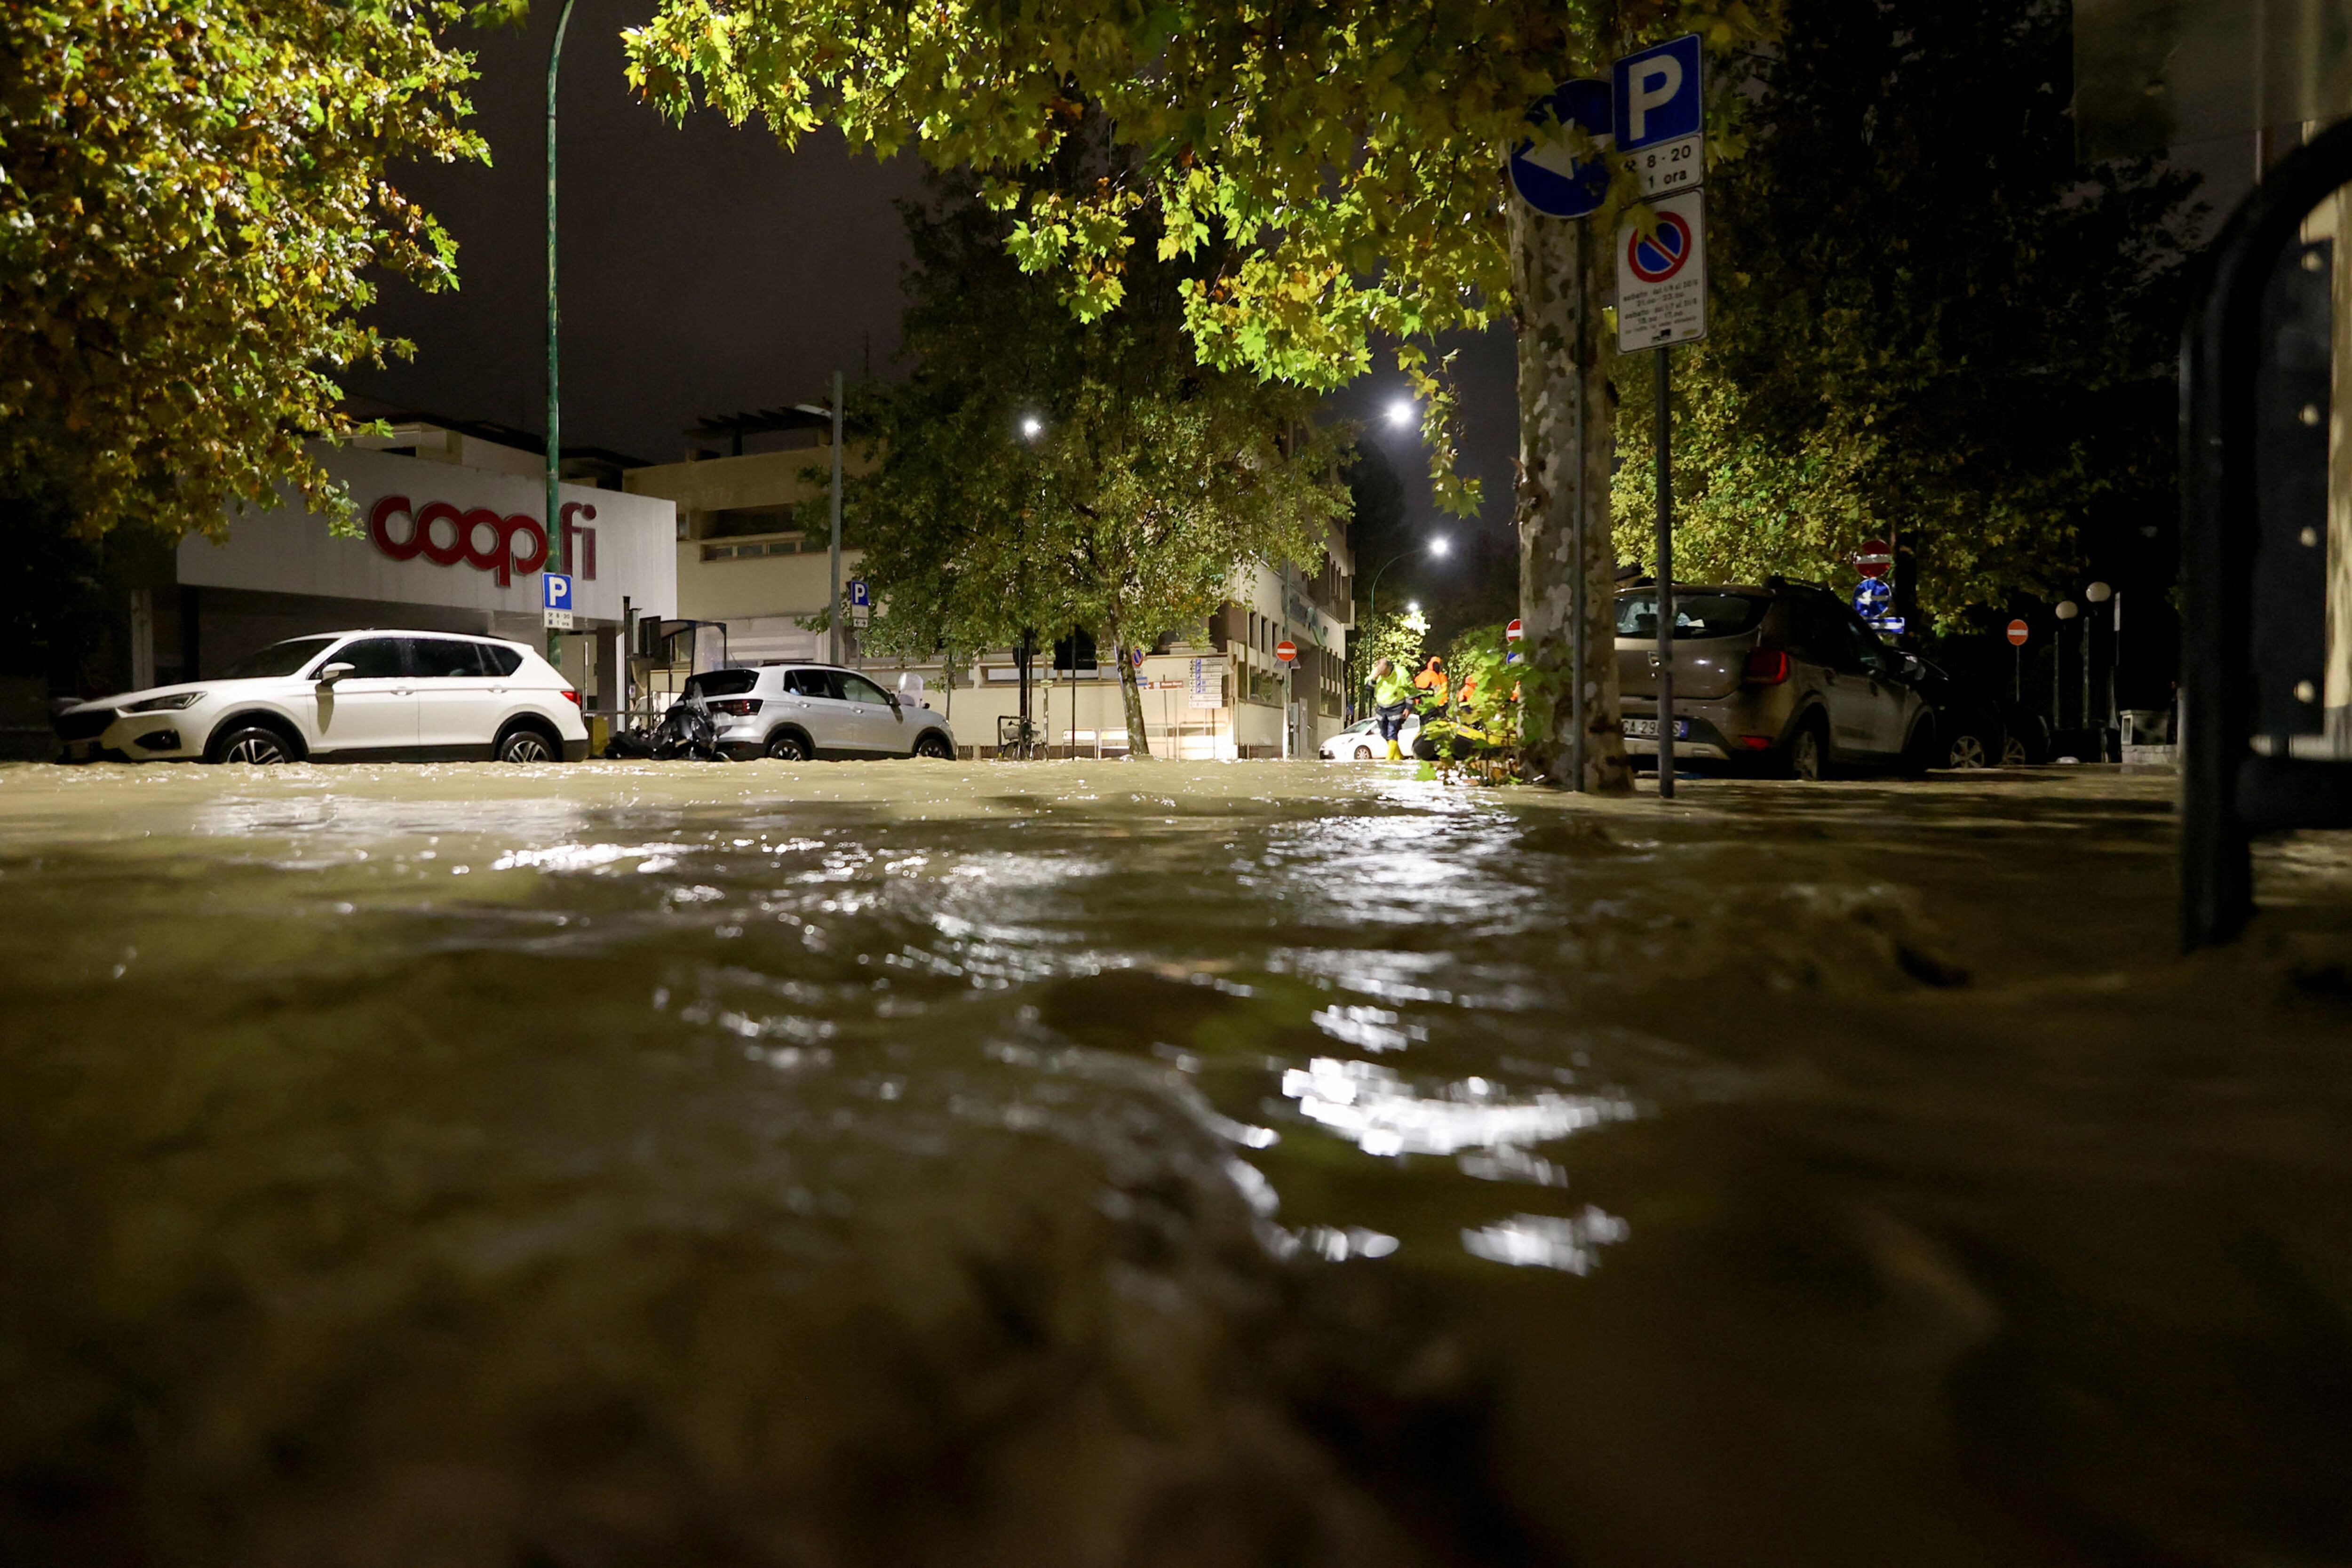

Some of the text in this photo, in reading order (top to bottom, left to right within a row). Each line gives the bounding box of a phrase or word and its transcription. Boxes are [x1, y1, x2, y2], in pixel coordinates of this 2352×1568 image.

[1629, 54, 1683, 142] P
[1647, 155, 1656, 167] 8
[1671, 145, 1691, 161] 20
[1649, 170, 1686, 188] 1 ora
[370, 494, 549, 588] coop
[549, 577, 567, 605] P
[855, 583, 866, 604] P
